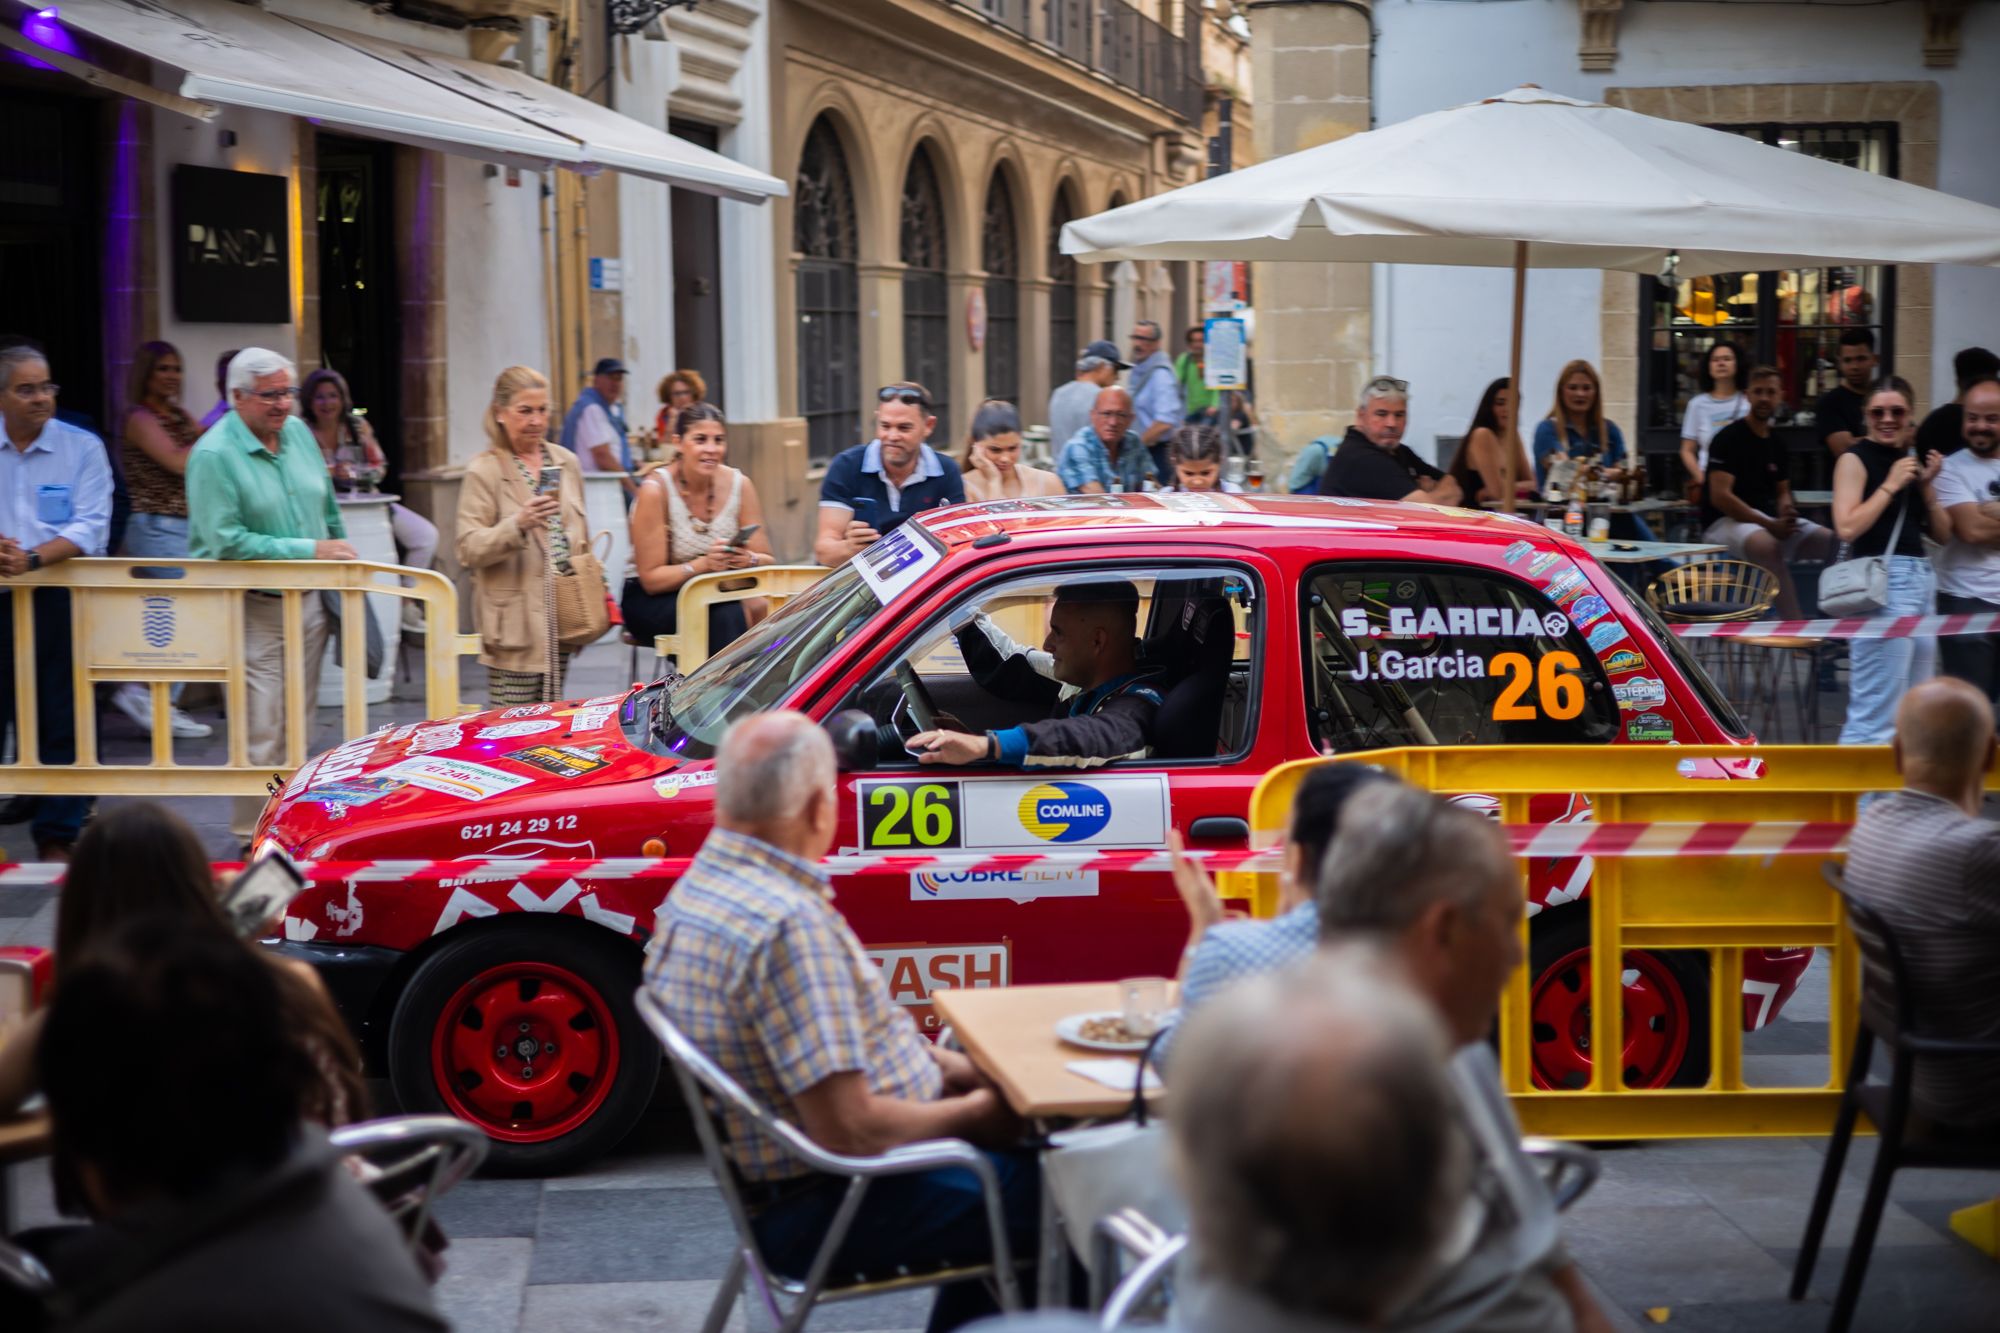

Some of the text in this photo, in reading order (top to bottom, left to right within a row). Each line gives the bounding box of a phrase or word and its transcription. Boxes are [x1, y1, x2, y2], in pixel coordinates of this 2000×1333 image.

[188, 223, 279, 267] PANDA
[1342, 607, 1382, 636] S.
[1390, 607, 1546, 636] GARCIA
[1352, 649, 1485, 681] J.Garcia
[1489, 651, 1586, 721] 26
[460, 815, 578, 840] 621 24 29 12
[870, 784, 953, 846] 26
[1040, 803, 1105, 818] COMLINE
[869, 953, 1001, 1001] ASH
